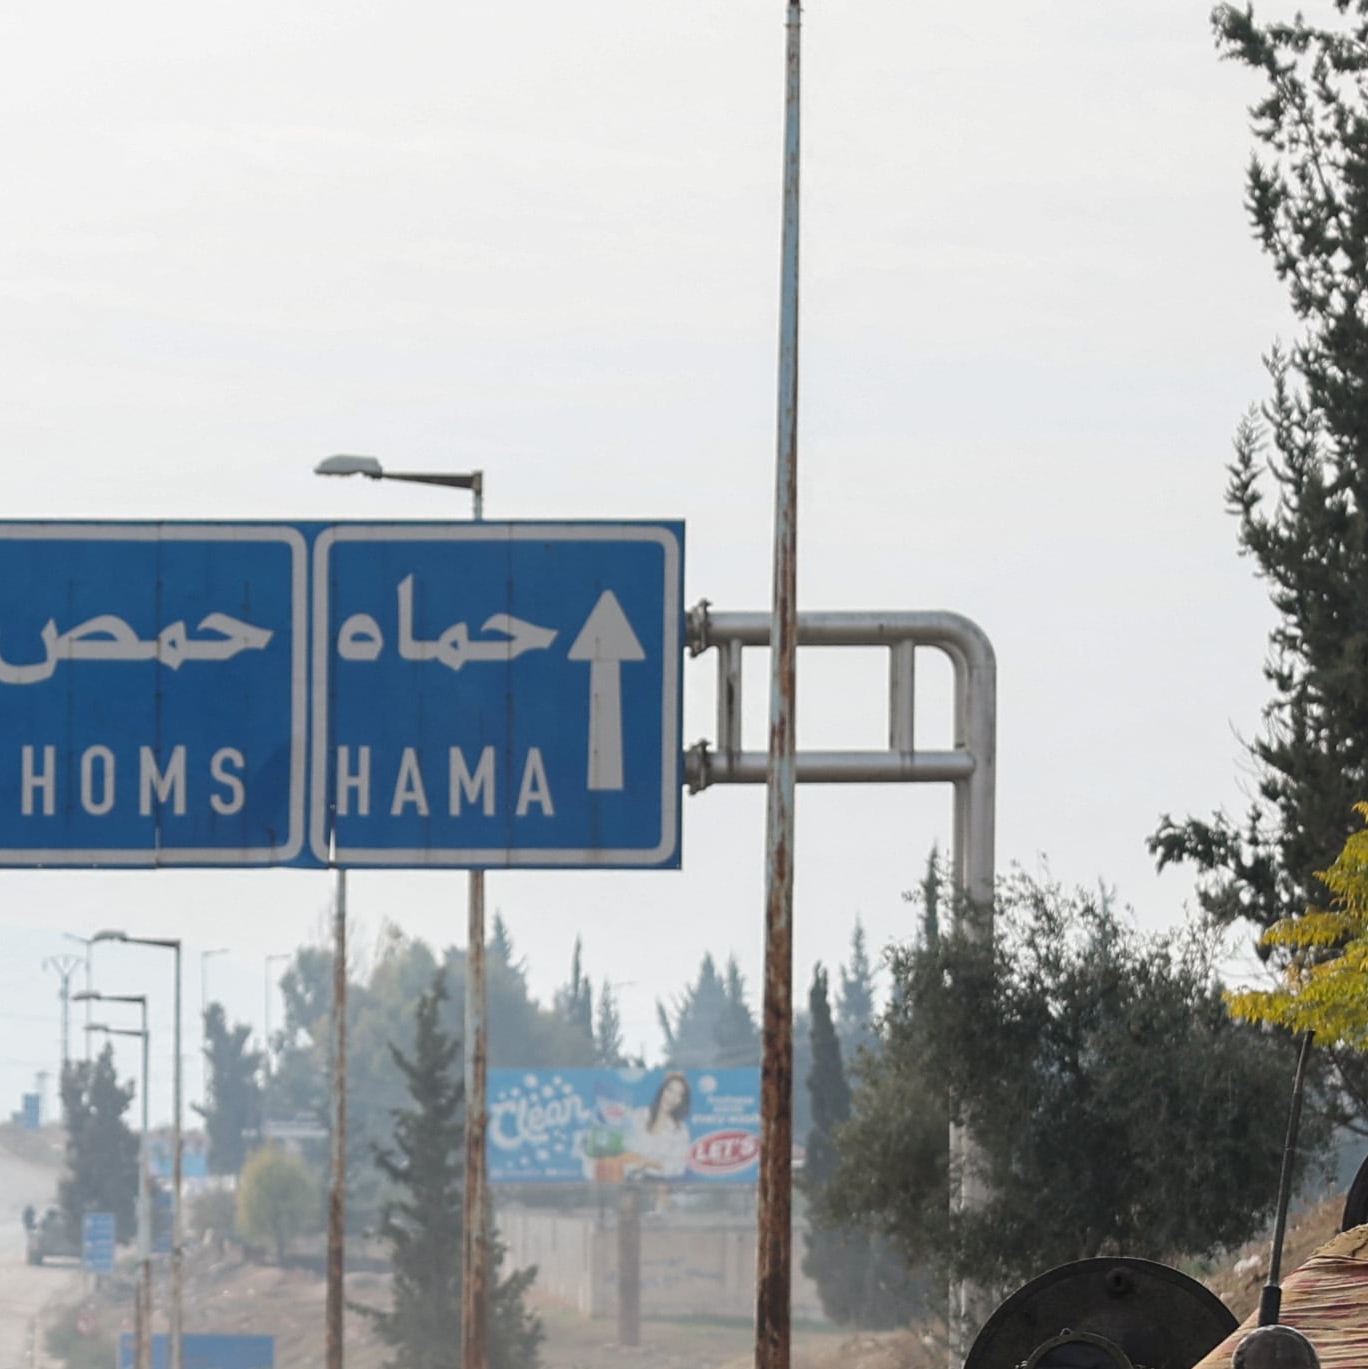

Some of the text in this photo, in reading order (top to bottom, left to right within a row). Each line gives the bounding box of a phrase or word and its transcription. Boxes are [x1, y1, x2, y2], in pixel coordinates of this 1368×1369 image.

[21, 745, 246, 816] HOMS
[335, 745, 555, 817] HAMA
[489, 1094, 590, 1150] Clean
